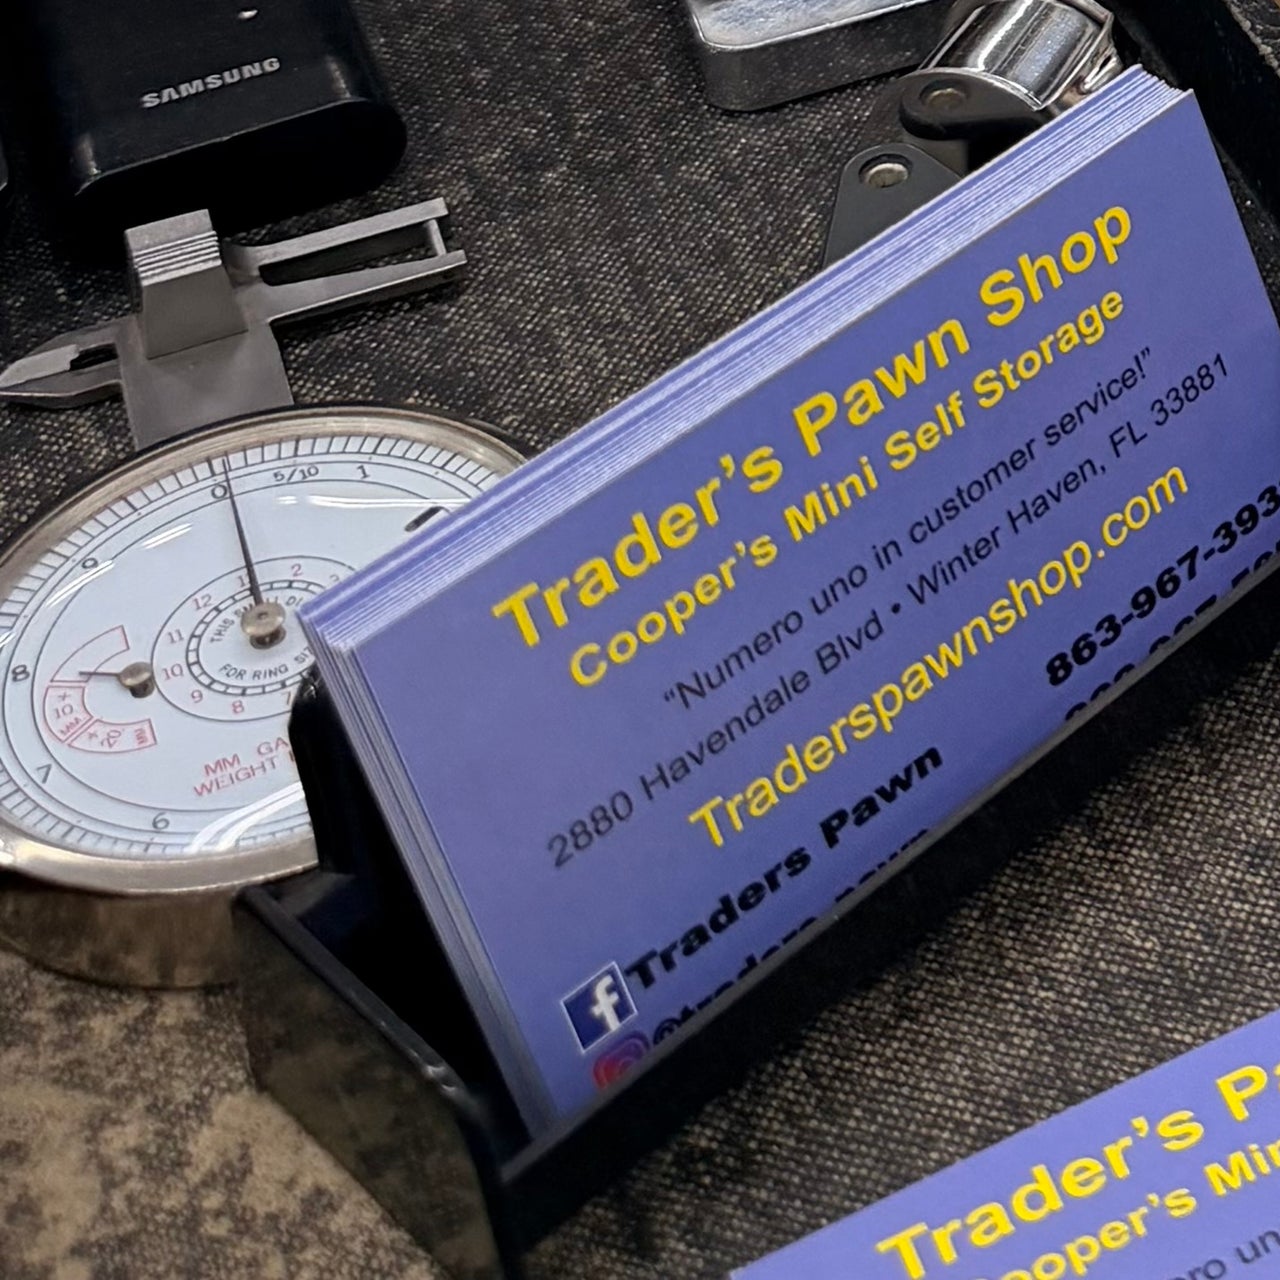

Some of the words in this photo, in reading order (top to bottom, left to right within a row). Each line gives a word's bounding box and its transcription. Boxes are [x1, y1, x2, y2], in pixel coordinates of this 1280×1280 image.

[139, 56, 281, 110] SAMSUNG
[492, 442, 784, 648] Trader's
[791, 315, 971, 457] Pawn
[978, 203, 1133, 327] Shop
[272, 465, 321, 483] 5/10
[356, 464, 371, 481] 1
[568, 531, 778, 689] Cooper's
[783, 454, 880, 544] Mini
[884, 391, 967, 472] Self
[976, 286, 1125, 411] Storage
[663, 611, 805, 713] "Numero
[811, 562, 870, 618] uno
[874, 537, 905, 578] in
[908, 441, 1038, 547] customer
[1042, 345, 1156, 447] service!"
[192, 593, 214, 612] 12
[290, 563, 304, 578] 2
[544, 789, 636, 871] 2880
[638, 669, 813, 803] Havendale
[817, 612, 886, 679] Blvd
[905, 528, 1007, 611] Winter
[1007, 457, 1109, 540] Haven,
[1109, 415, 1151, 461] FL
[1150, 352, 1232, 430] 33881
[166, 628, 185, 645] 11
[210, 617, 236, 644] THIS
[687, 465, 1190, 850] Traderspawnshop.com
[11, 663, 31, 683] 8
[161, 663, 185, 682] 10
[219, 663, 247, 681] FOR
[252, 663, 290, 681] RING
[53, 703, 75, 720] 10
[190, 689, 204, 704] 9
[231, 699, 246, 715] 8
[36, 763, 53, 785] 7
[192, 754, 280, 797] WEIGHT
[204, 753, 241, 777] MM
[151, 811, 171, 832] 6
[625, 845, 812, 990] Traders
[819, 742, 945, 849] Pawn
[875, 1107, 1206, 1280] Trader's
